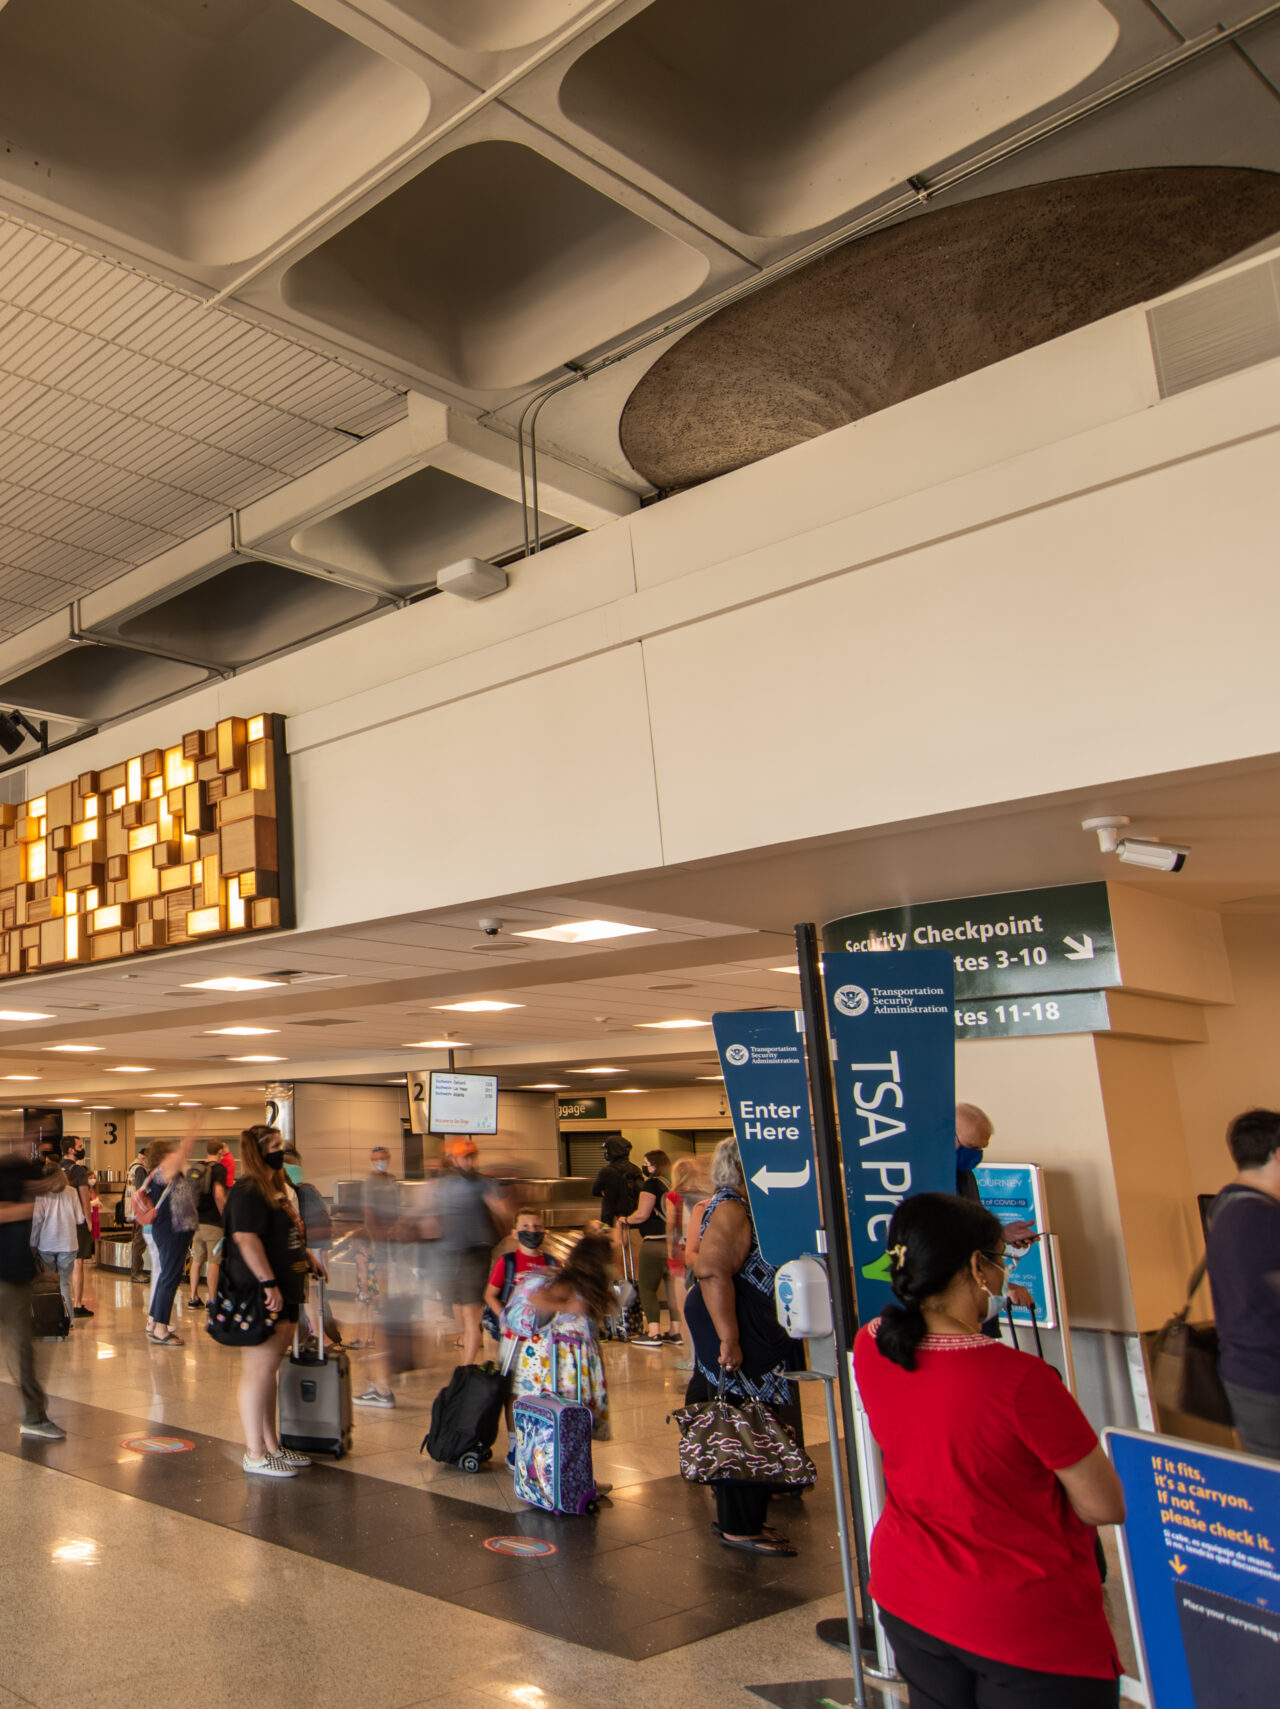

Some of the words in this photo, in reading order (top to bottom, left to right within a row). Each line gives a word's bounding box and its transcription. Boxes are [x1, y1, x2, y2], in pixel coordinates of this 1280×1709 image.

[845, 931, 907, 953] Security
[913, 914, 1043, 945] Checkpoint
[954, 955, 989, 972] tes
[995, 946, 1048, 969] 3-10
[871, 986, 944, 997] Transportation
[873, 996, 914, 1006] Security
[874, 1004, 949, 1014] Administration
[954, 1009, 988, 1026] tes
[995, 1001, 1061, 1024] 11-18
[750, 1046, 798, 1054] Transportation
[414, 1082, 425, 1102] 2
[851, 1050, 907, 1147] TSA
[740, 1100, 801, 1119] Enter
[103, 1122, 118, 1145] 3
[744, 1121, 800, 1140] Here
[1151, 1456, 1162, 1470] If
[1164, 1459, 1176, 1474] it
[1177, 1461, 1206, 1484] fits,
[1154, 1472, 1175, 1490] it's
[1177, 1481, 1187, 1493] a
[1188, 1484, 1254, 1512] carryon.
[1157, 1490, 1168, 1504] If
[1170, 1495, 1200, 1515] not,
[1160, 1509, 1207, 1532] please
[1209, 1521, 1255, 1546] check
[1256, 1533, 1276, 1553] it.
[1171, 1532, 1191, 1545] cabe,
[1200, 1541, 1235, 1559] equipaje
[1235, 1551, 1246, 1561] de
[1182, 1597, 1205, 1613] Place
[1205, 1607, 1226, 1620] your
[1226, 1615, 1261, 1631] carryon
